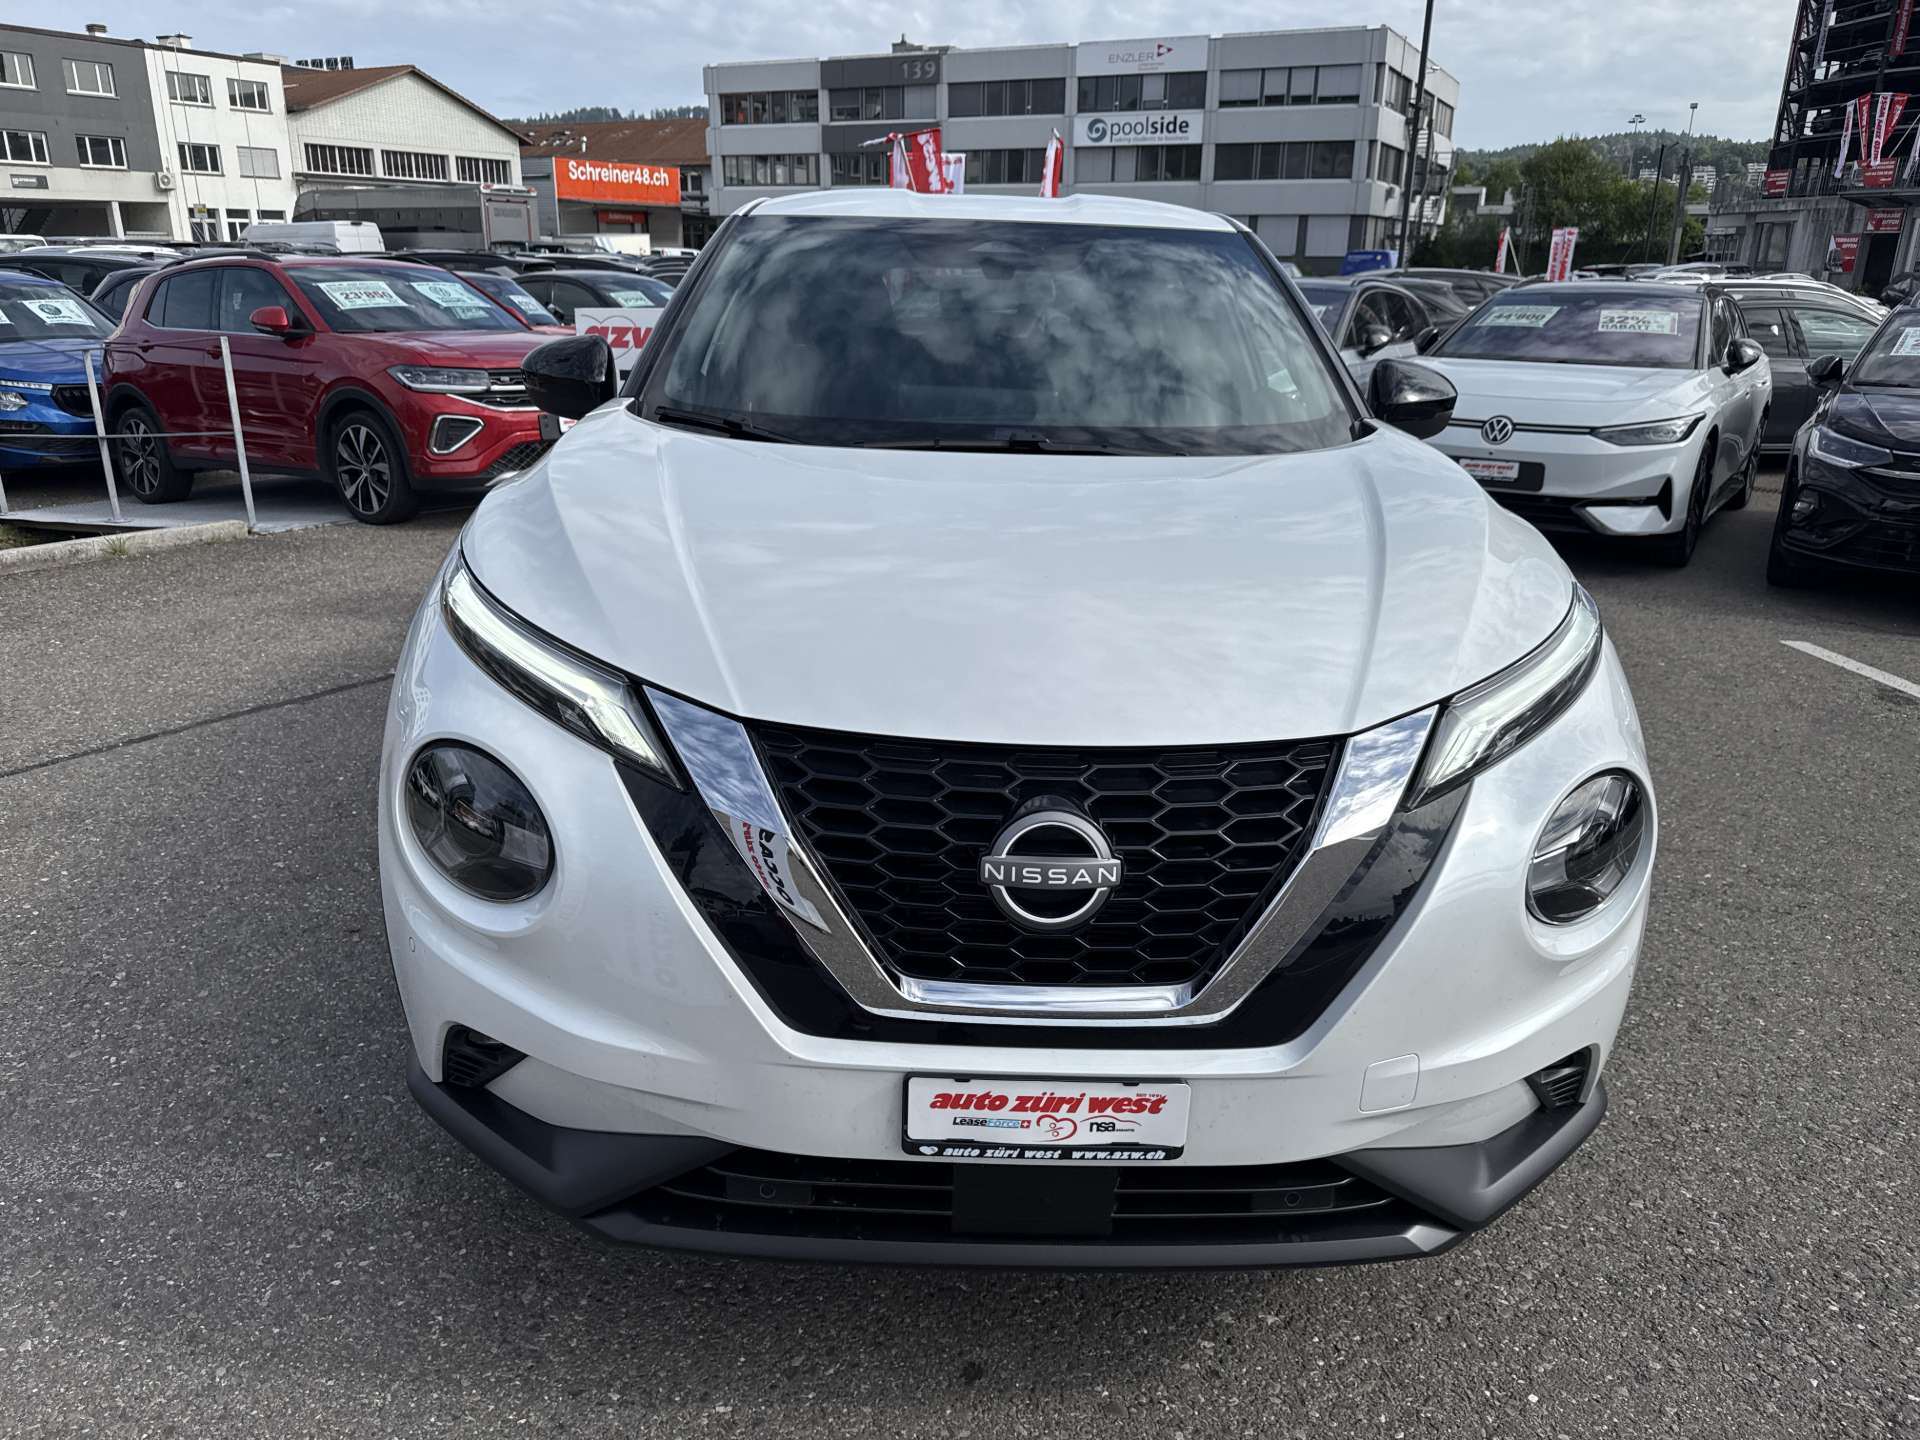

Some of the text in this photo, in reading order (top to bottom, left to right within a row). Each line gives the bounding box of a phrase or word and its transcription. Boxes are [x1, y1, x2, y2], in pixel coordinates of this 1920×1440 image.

[1108, 52, 1156, 64] ENZLER
[901, 61, 937, 79] 139
[1110, 116, 1190, 143] poolside
[568, 160, 670, 187] Schreiner48.ch
[984, 862, 1117, 885] NISSAN
[929, 1090, 1169, 1114] auto züri west
[1089, 1121, 1116, 1133] nsa
[942, 1147, 1167, 1160] auto züri west www.azw.ch
